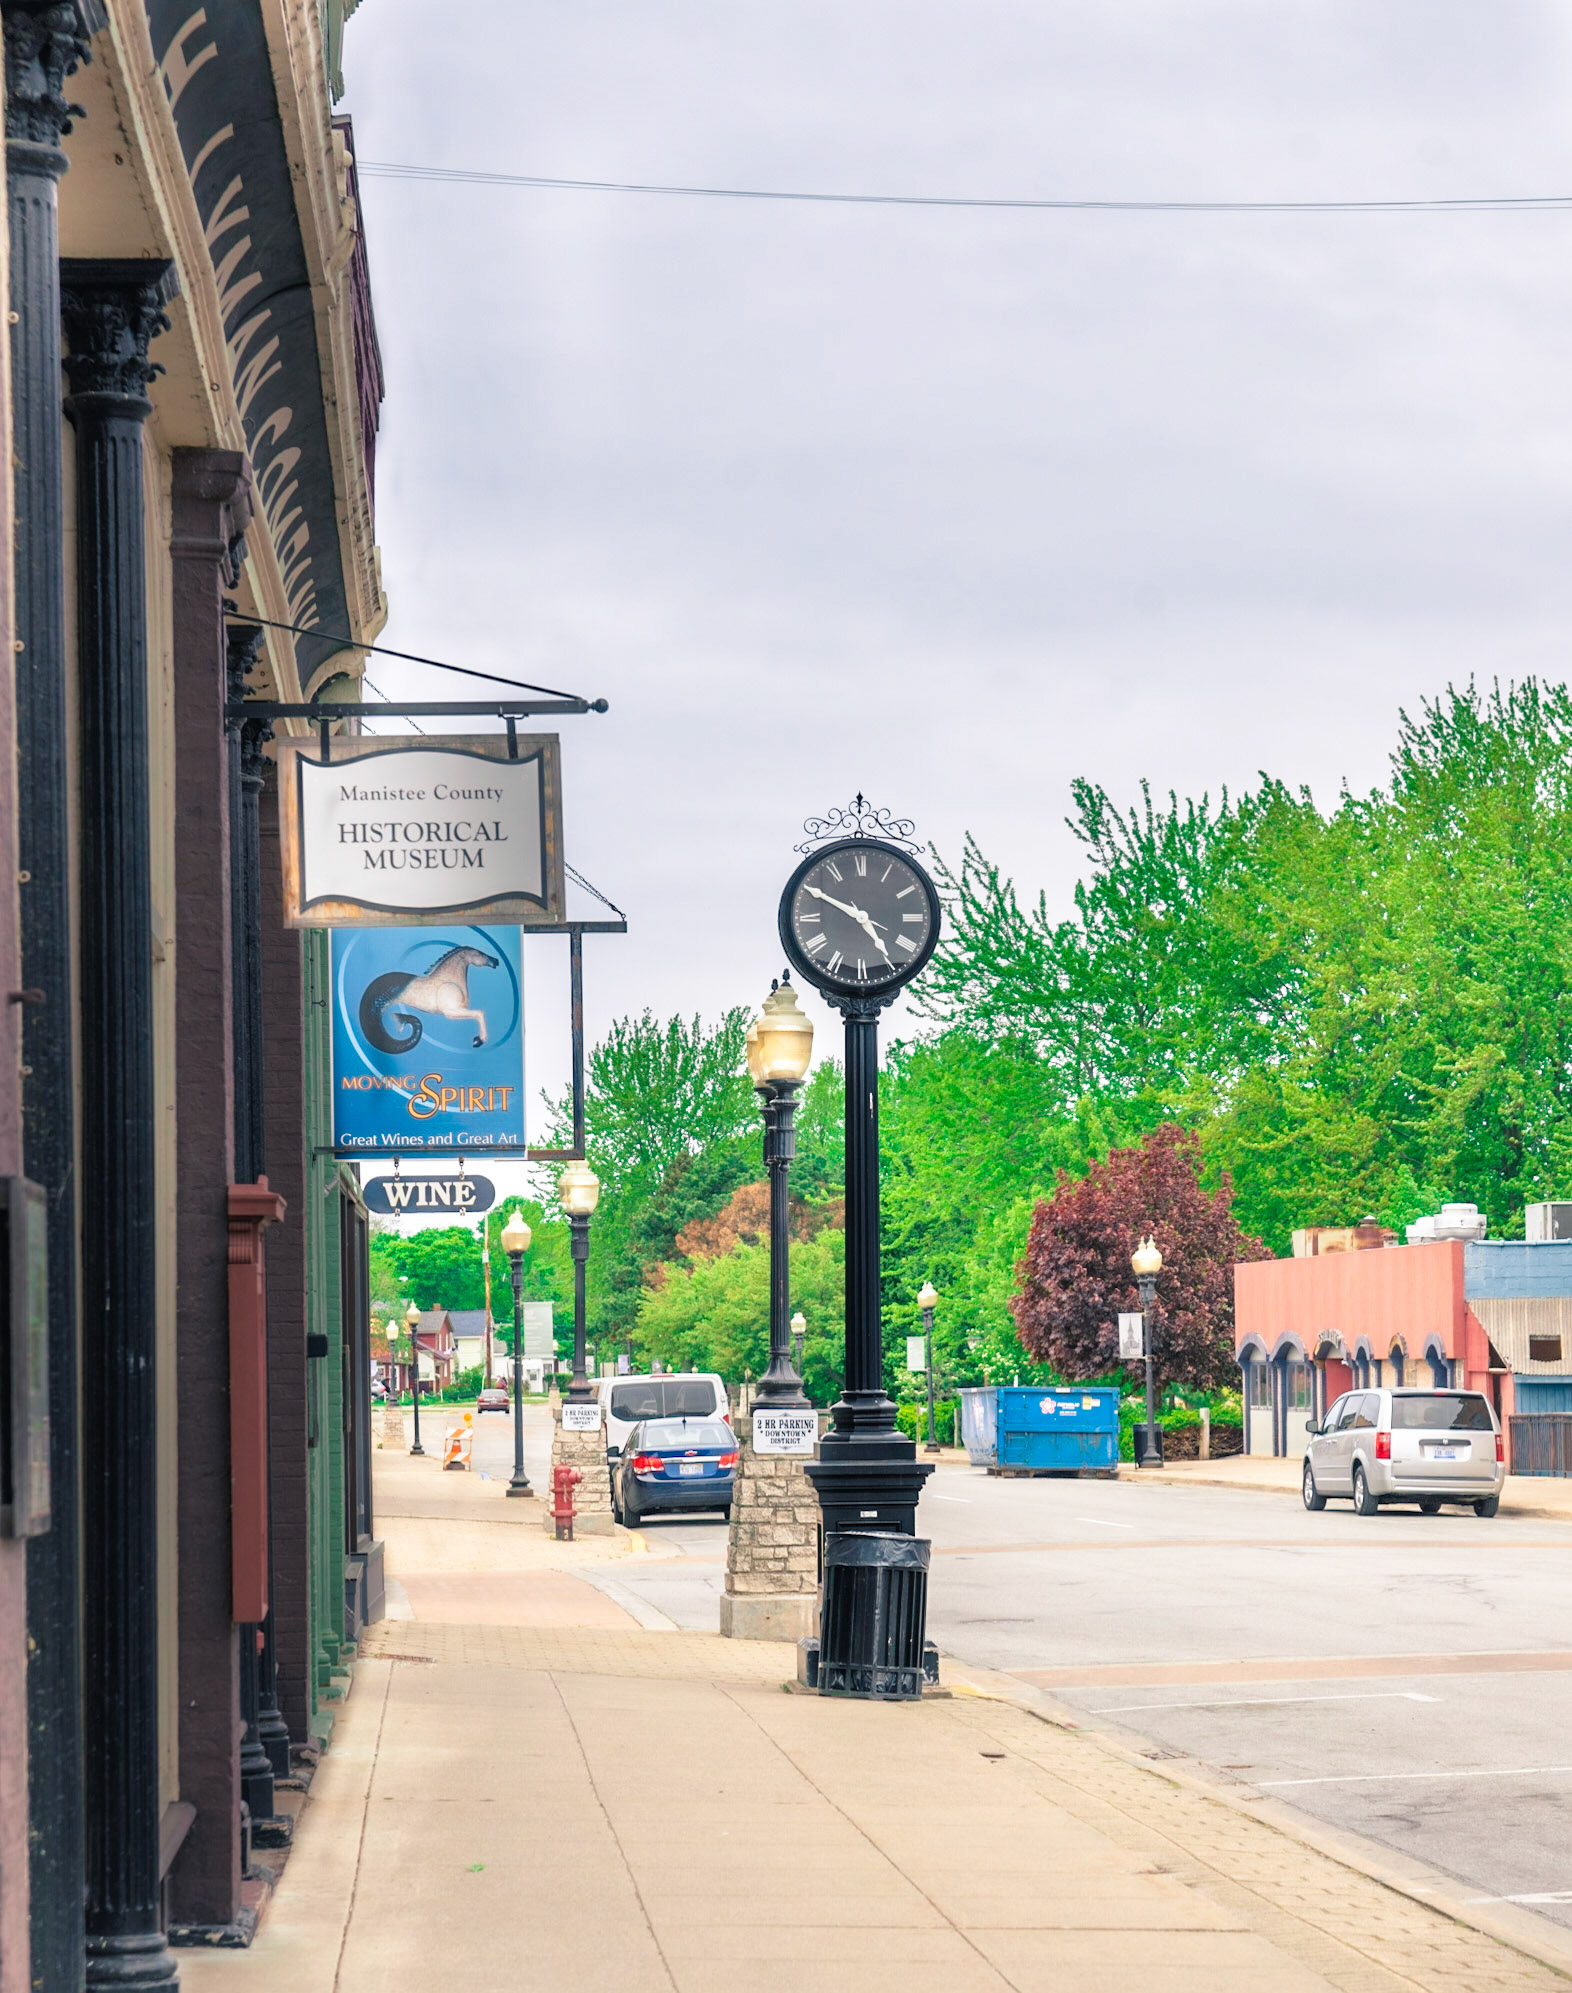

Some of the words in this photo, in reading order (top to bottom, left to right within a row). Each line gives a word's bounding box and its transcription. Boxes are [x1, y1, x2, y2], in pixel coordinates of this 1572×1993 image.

[340, 785, 426, 801] Manistee
[434, 784, 504, 803] County
[338, 821, 509, 843] HISTORICAL
[363, 848, 485, 869] MUSEUM
[342, 1075, 416, 1090] MOVING
[408, 1073, 514, 1119] SPIRIT
[340, 1133, 377, 1146] Great
[382, 1133, 423, 1145] Wines
[427, 1132, 453, 1145] and
[457, 1132, 493, 1144] Great
[498, 1132, 517, 1144] Art
[383, 1181, 477, 1207] WINE
[757, 1419, 762, 1429] 2
[765, 1419, 776, 1429] HR
[779, 1419, 814, 1429] PARKING
